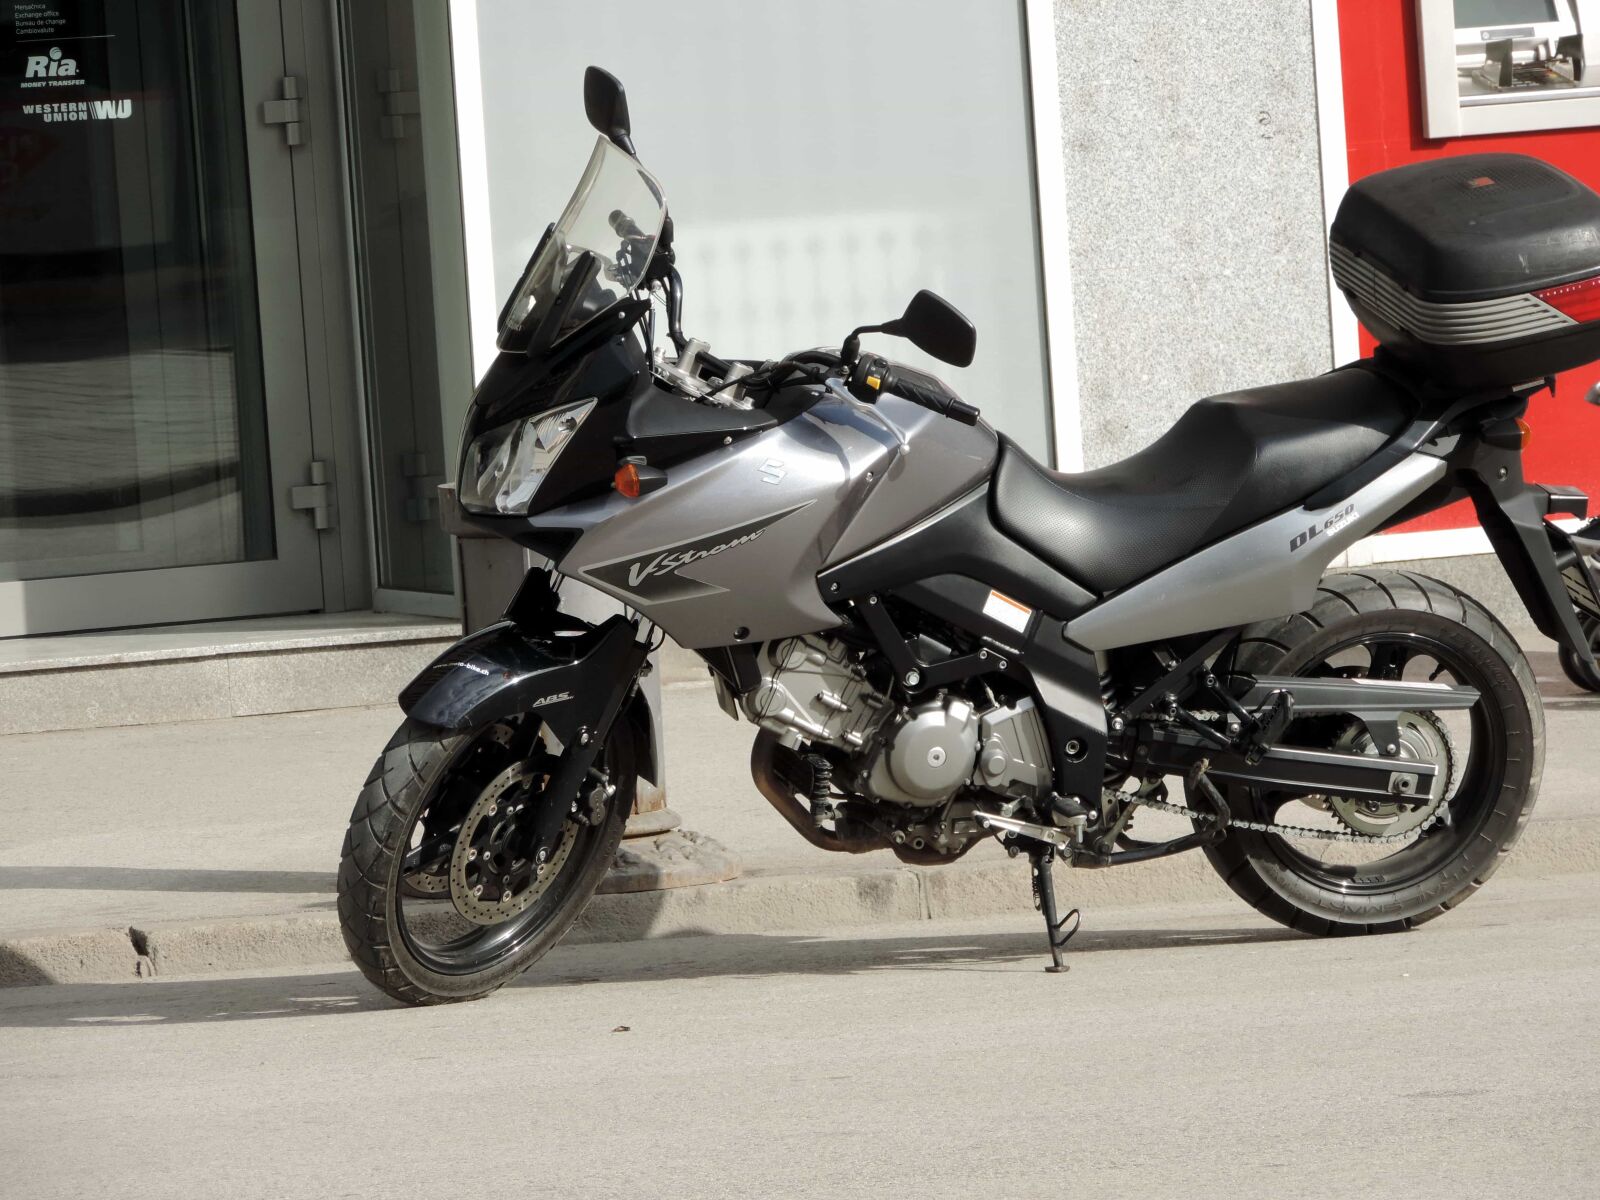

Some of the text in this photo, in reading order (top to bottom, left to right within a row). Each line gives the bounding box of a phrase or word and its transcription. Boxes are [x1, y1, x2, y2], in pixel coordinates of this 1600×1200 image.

[25, 46, 78, 78] Ria
[20, 79, 86, 89] MONEY TRANSFER
[22, 101, 88, 114] WESTERN
[43, 111, 88, 123] UNION
[532, 691, 570, 708] ABS
